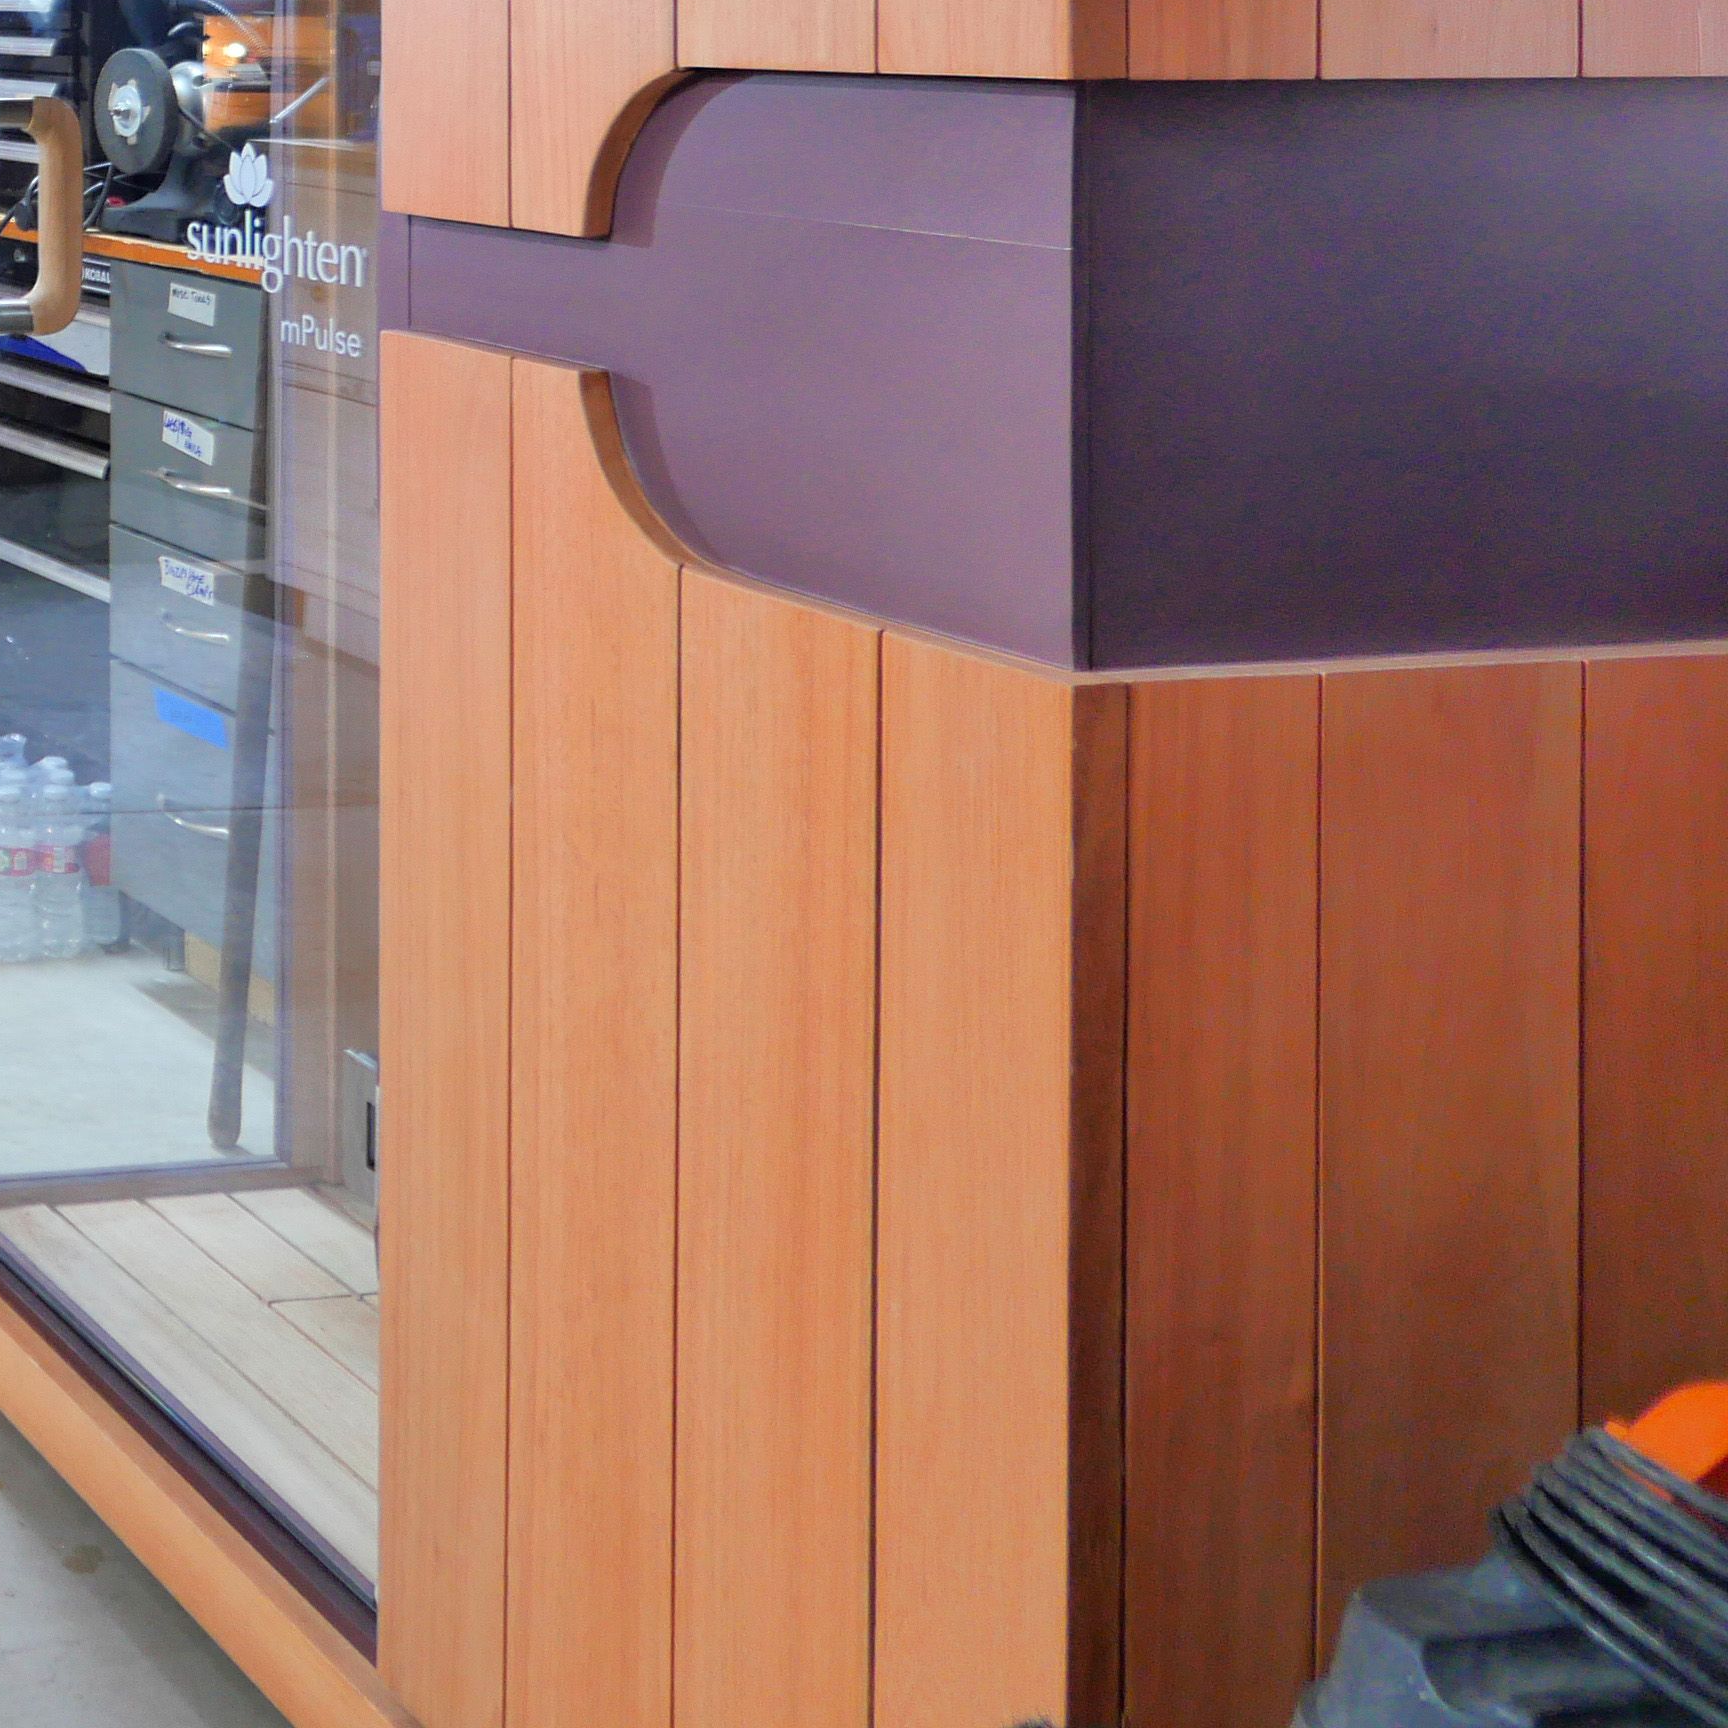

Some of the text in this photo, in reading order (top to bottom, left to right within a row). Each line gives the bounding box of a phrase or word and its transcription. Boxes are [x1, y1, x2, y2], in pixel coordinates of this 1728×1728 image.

[186, 210, 364, 294] sunlighten
[84, 268, 111, 284] KOBAL
[280, 315, 362, 357] mPulse
